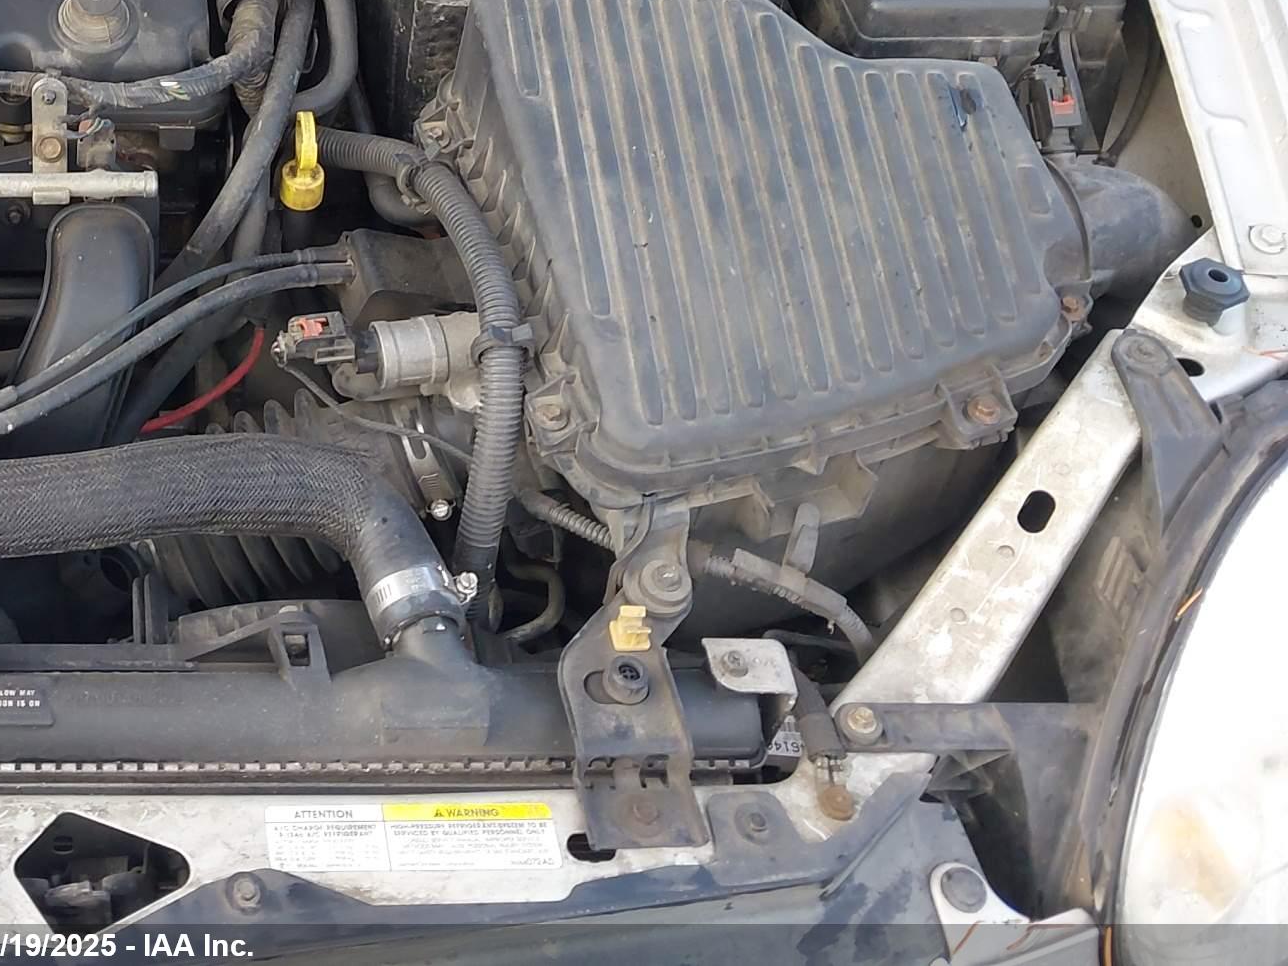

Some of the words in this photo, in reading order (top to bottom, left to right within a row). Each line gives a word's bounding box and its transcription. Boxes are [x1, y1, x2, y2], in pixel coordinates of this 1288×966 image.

[19, 689, 36, 697] MAY
[16, 699, 26, 707] IS
[29, 699, 41, 707] ON
[294, 810, 353, 819] ATTENTION
[446, 808, 500, 818] WARNING
